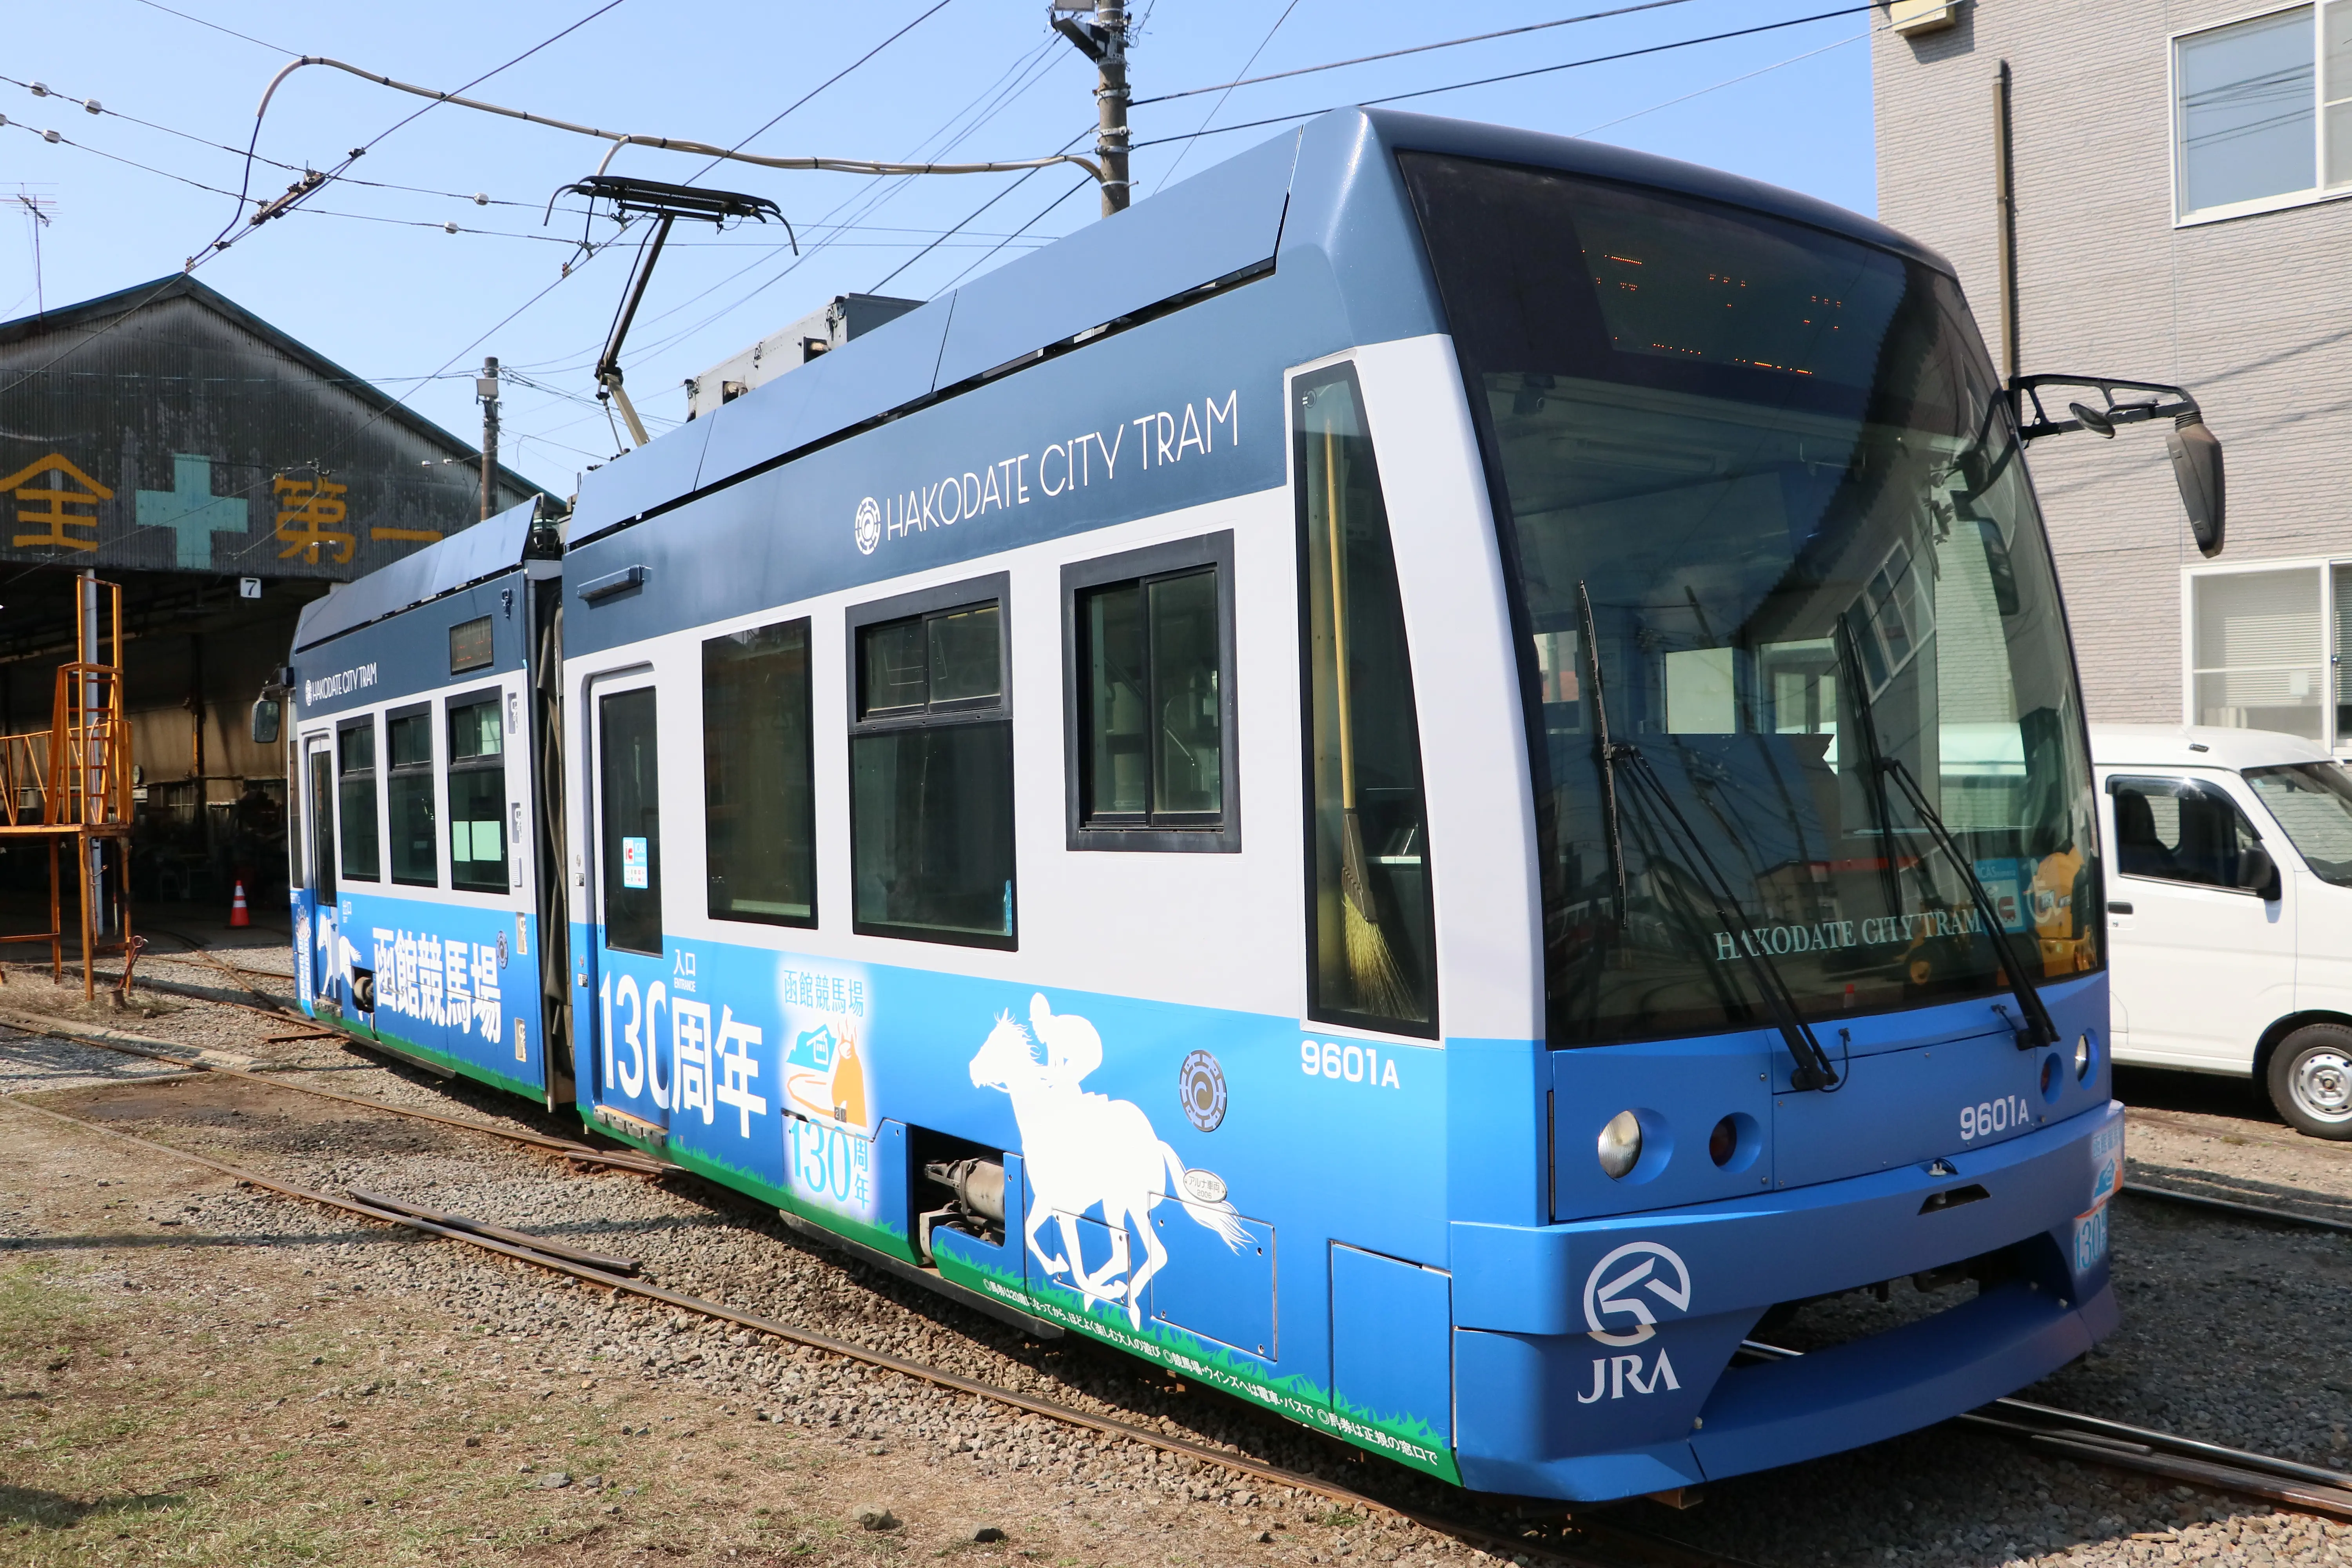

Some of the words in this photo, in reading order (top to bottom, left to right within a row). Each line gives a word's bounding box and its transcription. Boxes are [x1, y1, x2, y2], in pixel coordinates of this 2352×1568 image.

[887, 454, 1030, 541] HAKODATE
[1040, 424, 1124, 496] CITY
[1133, 390, 1237, 470] TRAM
[0, 453, 113, 552] 全
[245, 579, 257, 596] 7
[312, 674, 342, 701] HAKODATE
[342, 668, 358, 693] CITY
[358, 662, 377, 688] TRAM
[1862, 915, 1915, 945] CITY
[1918, 908, 1983, 938] TRAM
[373, 927, 501, 1043] 函館競馬場
[673, 949, 696, 976] 入口
[674, 978, 696, 992] ENTRANCE
[784, 970, 864, 1017] 函館競馬場
[1301, 1040, 1401, 1089] 9601A
[1960, 1095, 2029, 1140] 9601A
[1189, 1176, 1220, 1193] アルナ車両
[1197, 1189, 1212, 1199] 2006
[2075, 1214, 2101, 1269] 130
[1577, 1347, 1682, 1404] JRA
